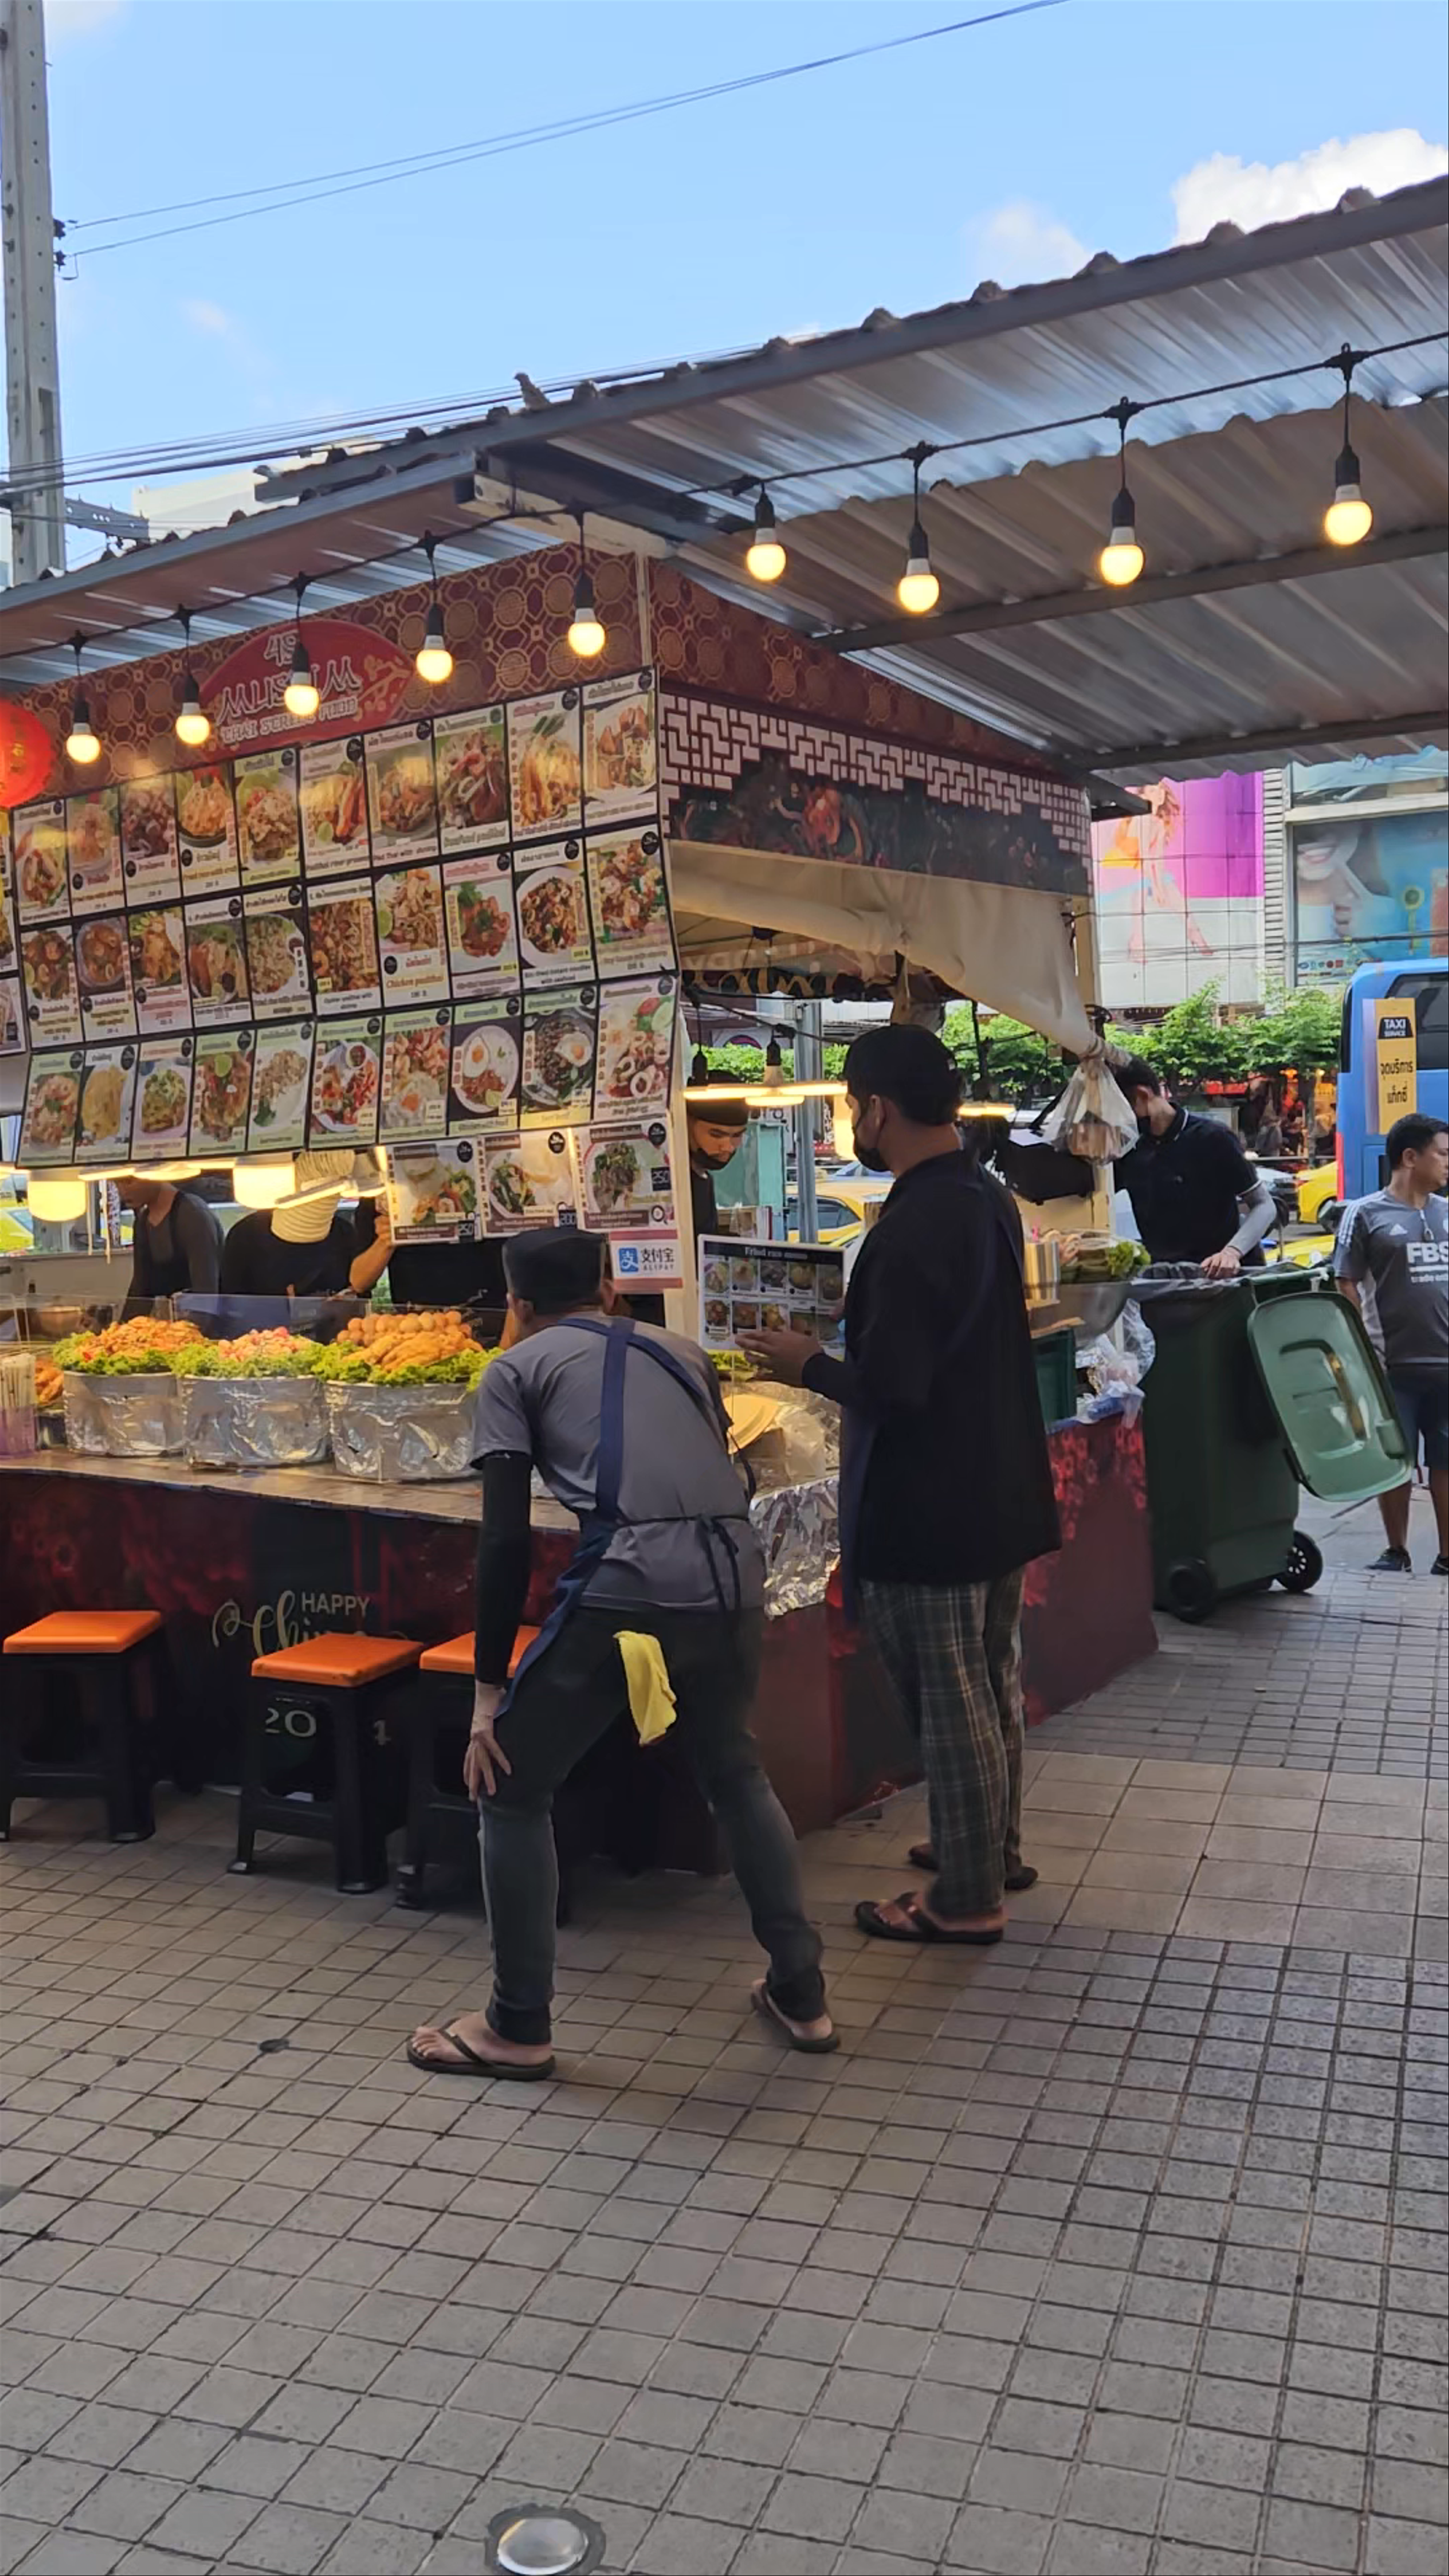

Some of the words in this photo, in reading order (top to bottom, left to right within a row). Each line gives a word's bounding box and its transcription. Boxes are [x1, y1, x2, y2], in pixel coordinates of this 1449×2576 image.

[215, 656, 363, 726] MUSIM
[1384, 1019, 1406, 1029] TAXI
[641, 1248, 674, 1263] 支付宝
[302, 1592, 370, 1617] HAPPY
